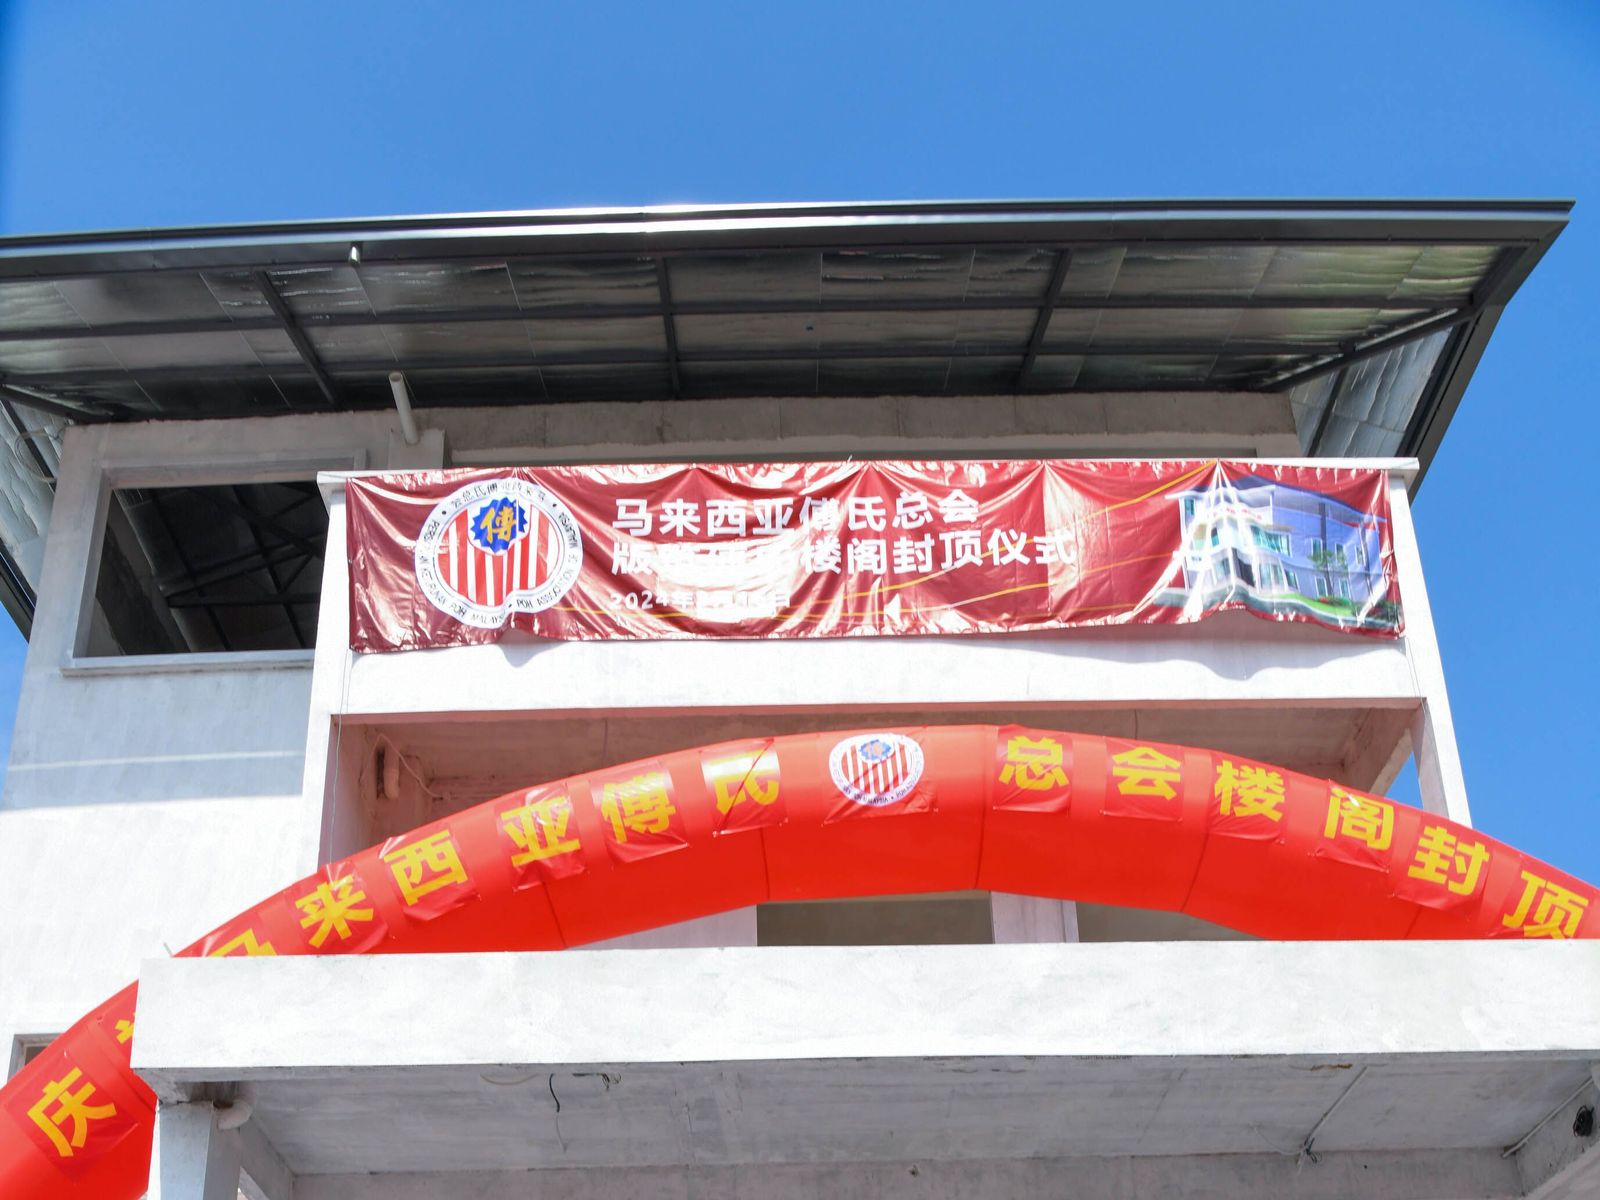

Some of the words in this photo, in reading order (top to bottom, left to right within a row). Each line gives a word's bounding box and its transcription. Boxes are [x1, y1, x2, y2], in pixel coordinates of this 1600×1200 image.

[480, 502, 518, 544] 傅
[612, 489, 980, 537] 马来西亚傅氏总会
[611, 527, 1077, 576] 版楼阁封顶仪式
